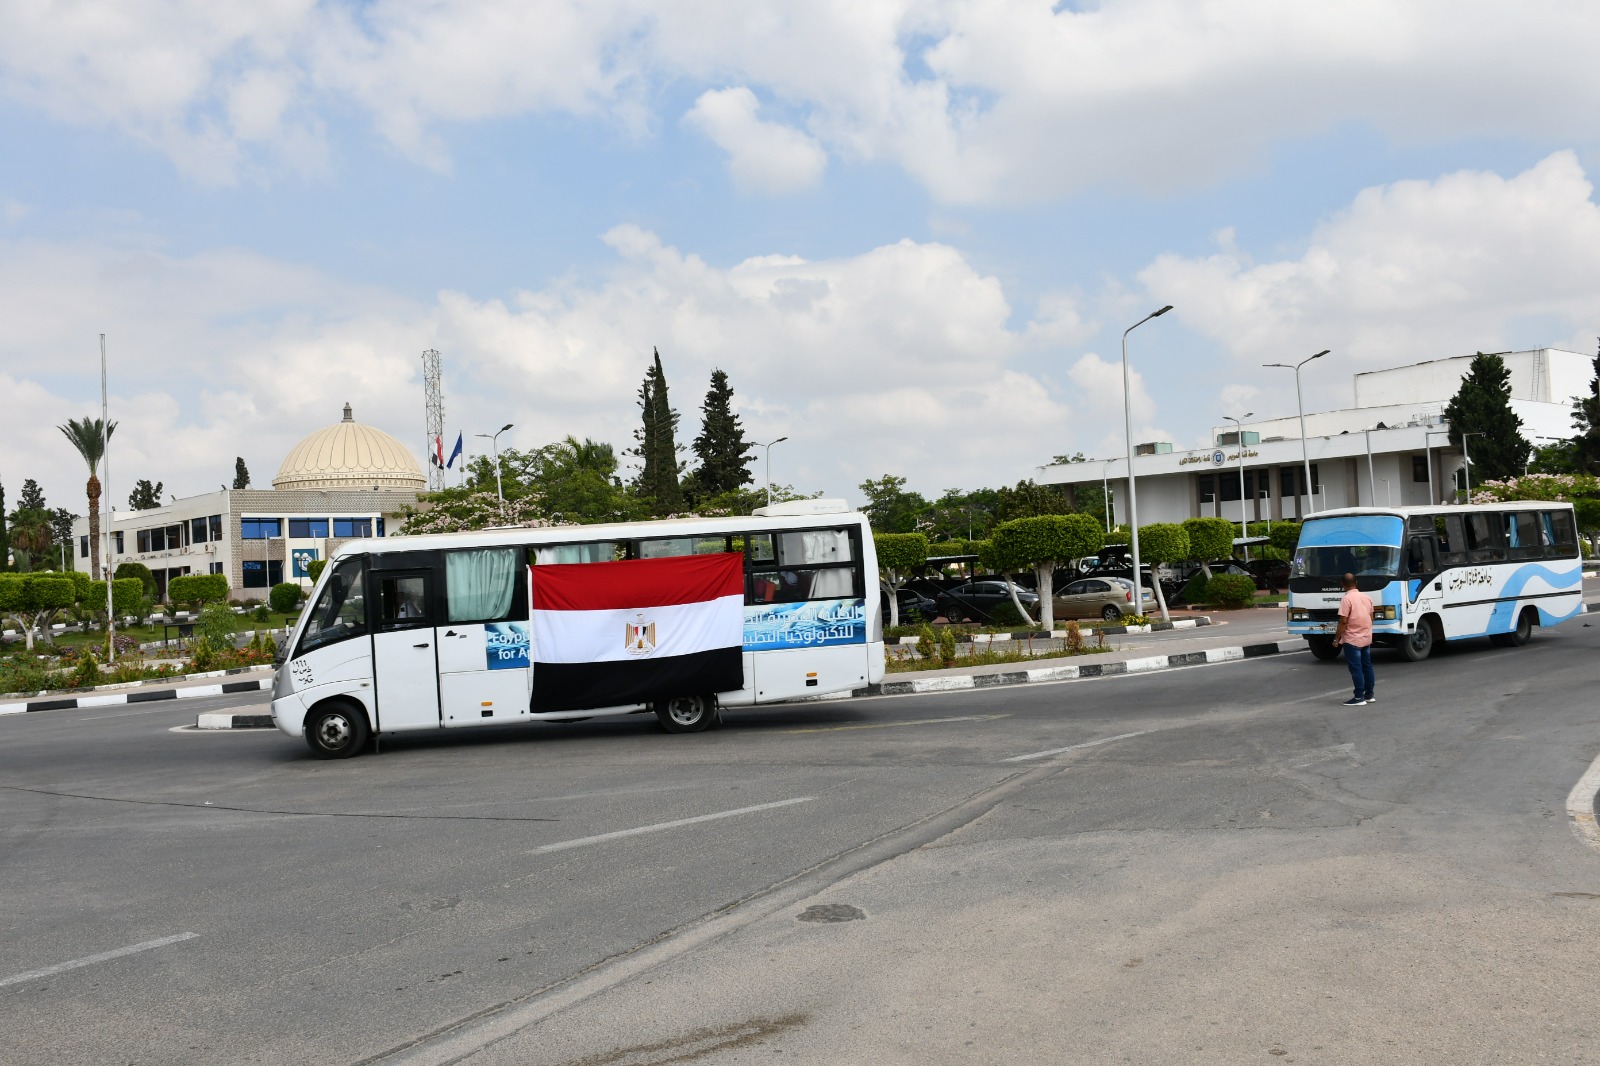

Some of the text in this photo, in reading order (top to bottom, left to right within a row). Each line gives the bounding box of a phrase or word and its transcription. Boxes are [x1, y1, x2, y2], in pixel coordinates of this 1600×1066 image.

[1227, 452, 1240, 461] لسويس
[1449, 571, 1468, 590] السويس
[1468, 568, 1478, 586] قناة
[768, 608, 817, 626] المصرية
[822, 606, 858, 622] الكلية
[785, 625, 854, 644] للتكنولوجيا
[498, 648, 516, 660] for
